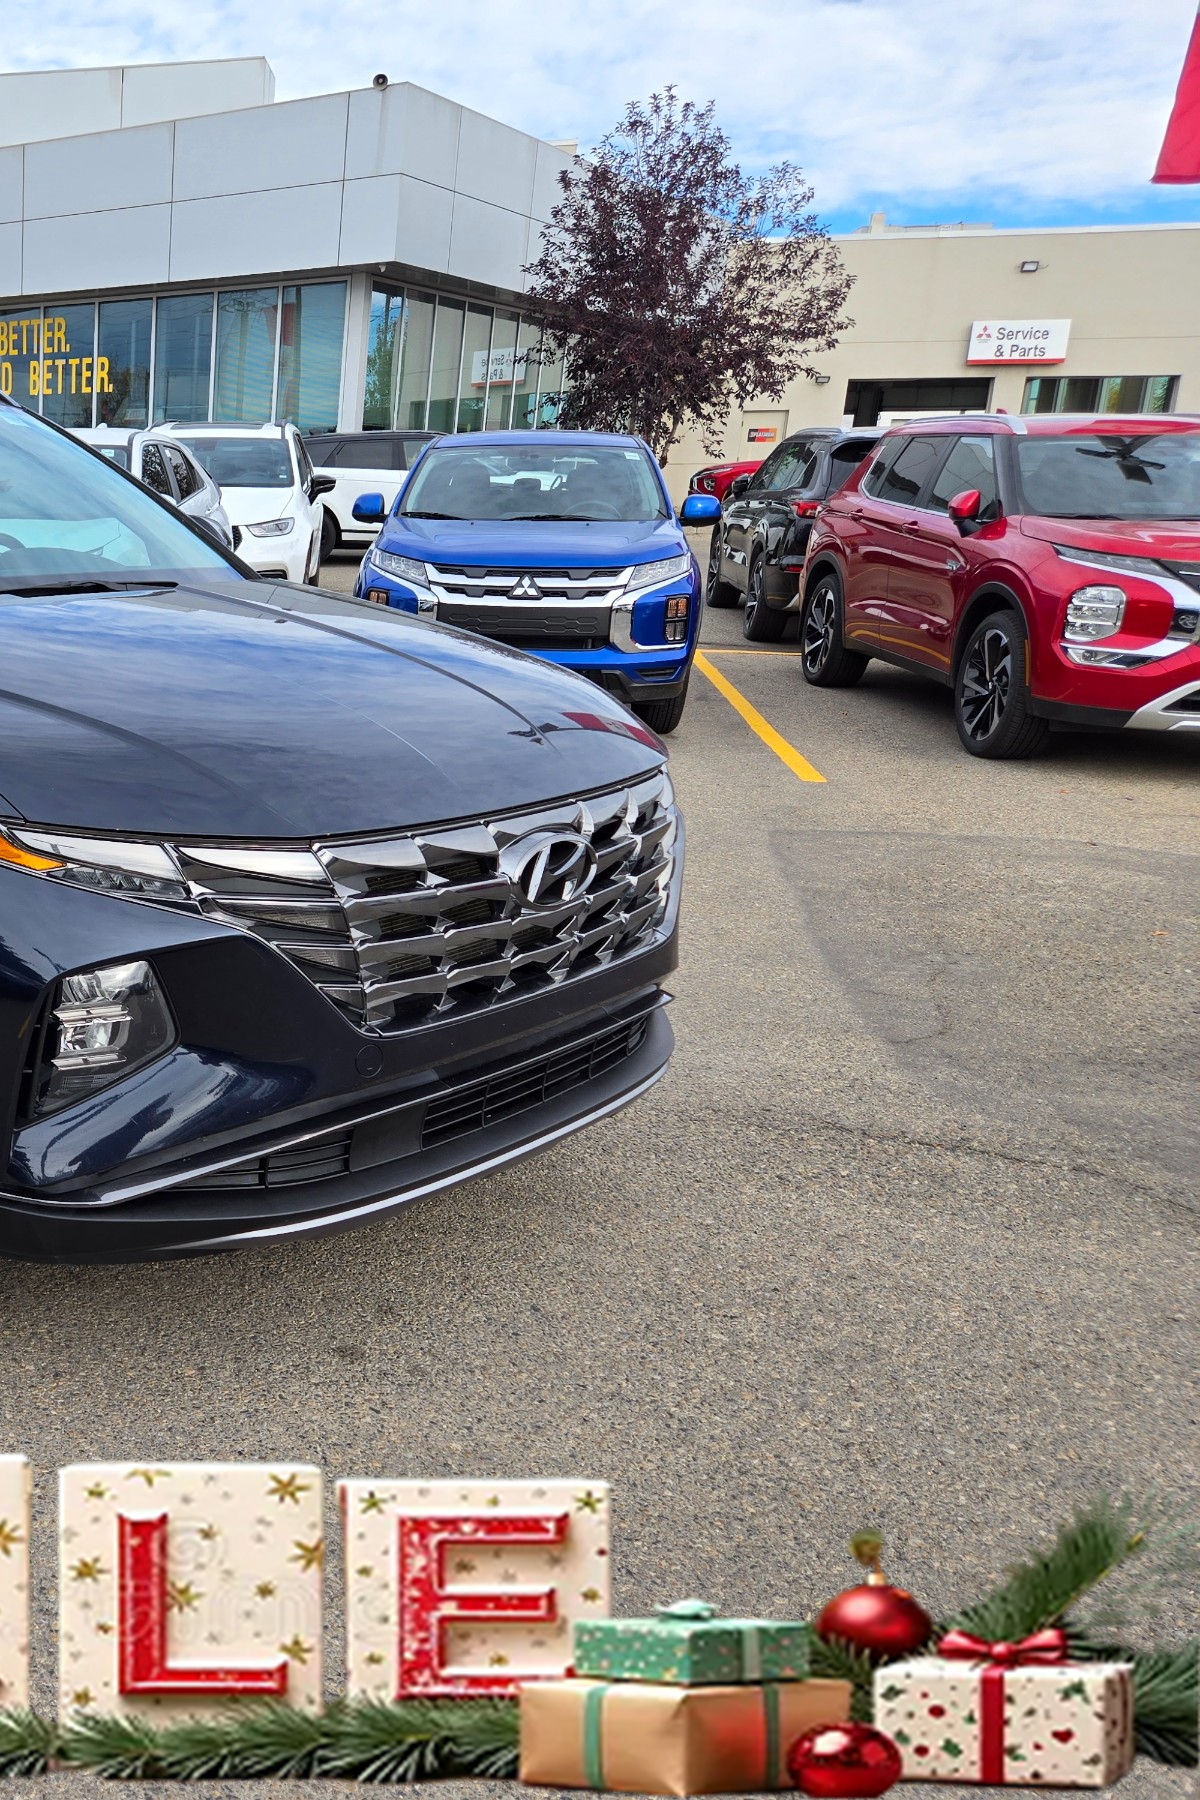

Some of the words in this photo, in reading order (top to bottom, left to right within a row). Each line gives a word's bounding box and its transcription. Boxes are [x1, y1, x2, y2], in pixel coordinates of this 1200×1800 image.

[996, 327, 1049, 340] Service
[994, 345, 1004, 357] &
[1009, 344, 1046, 357] Parts
[29, 357, 113, 396] BETTER.
